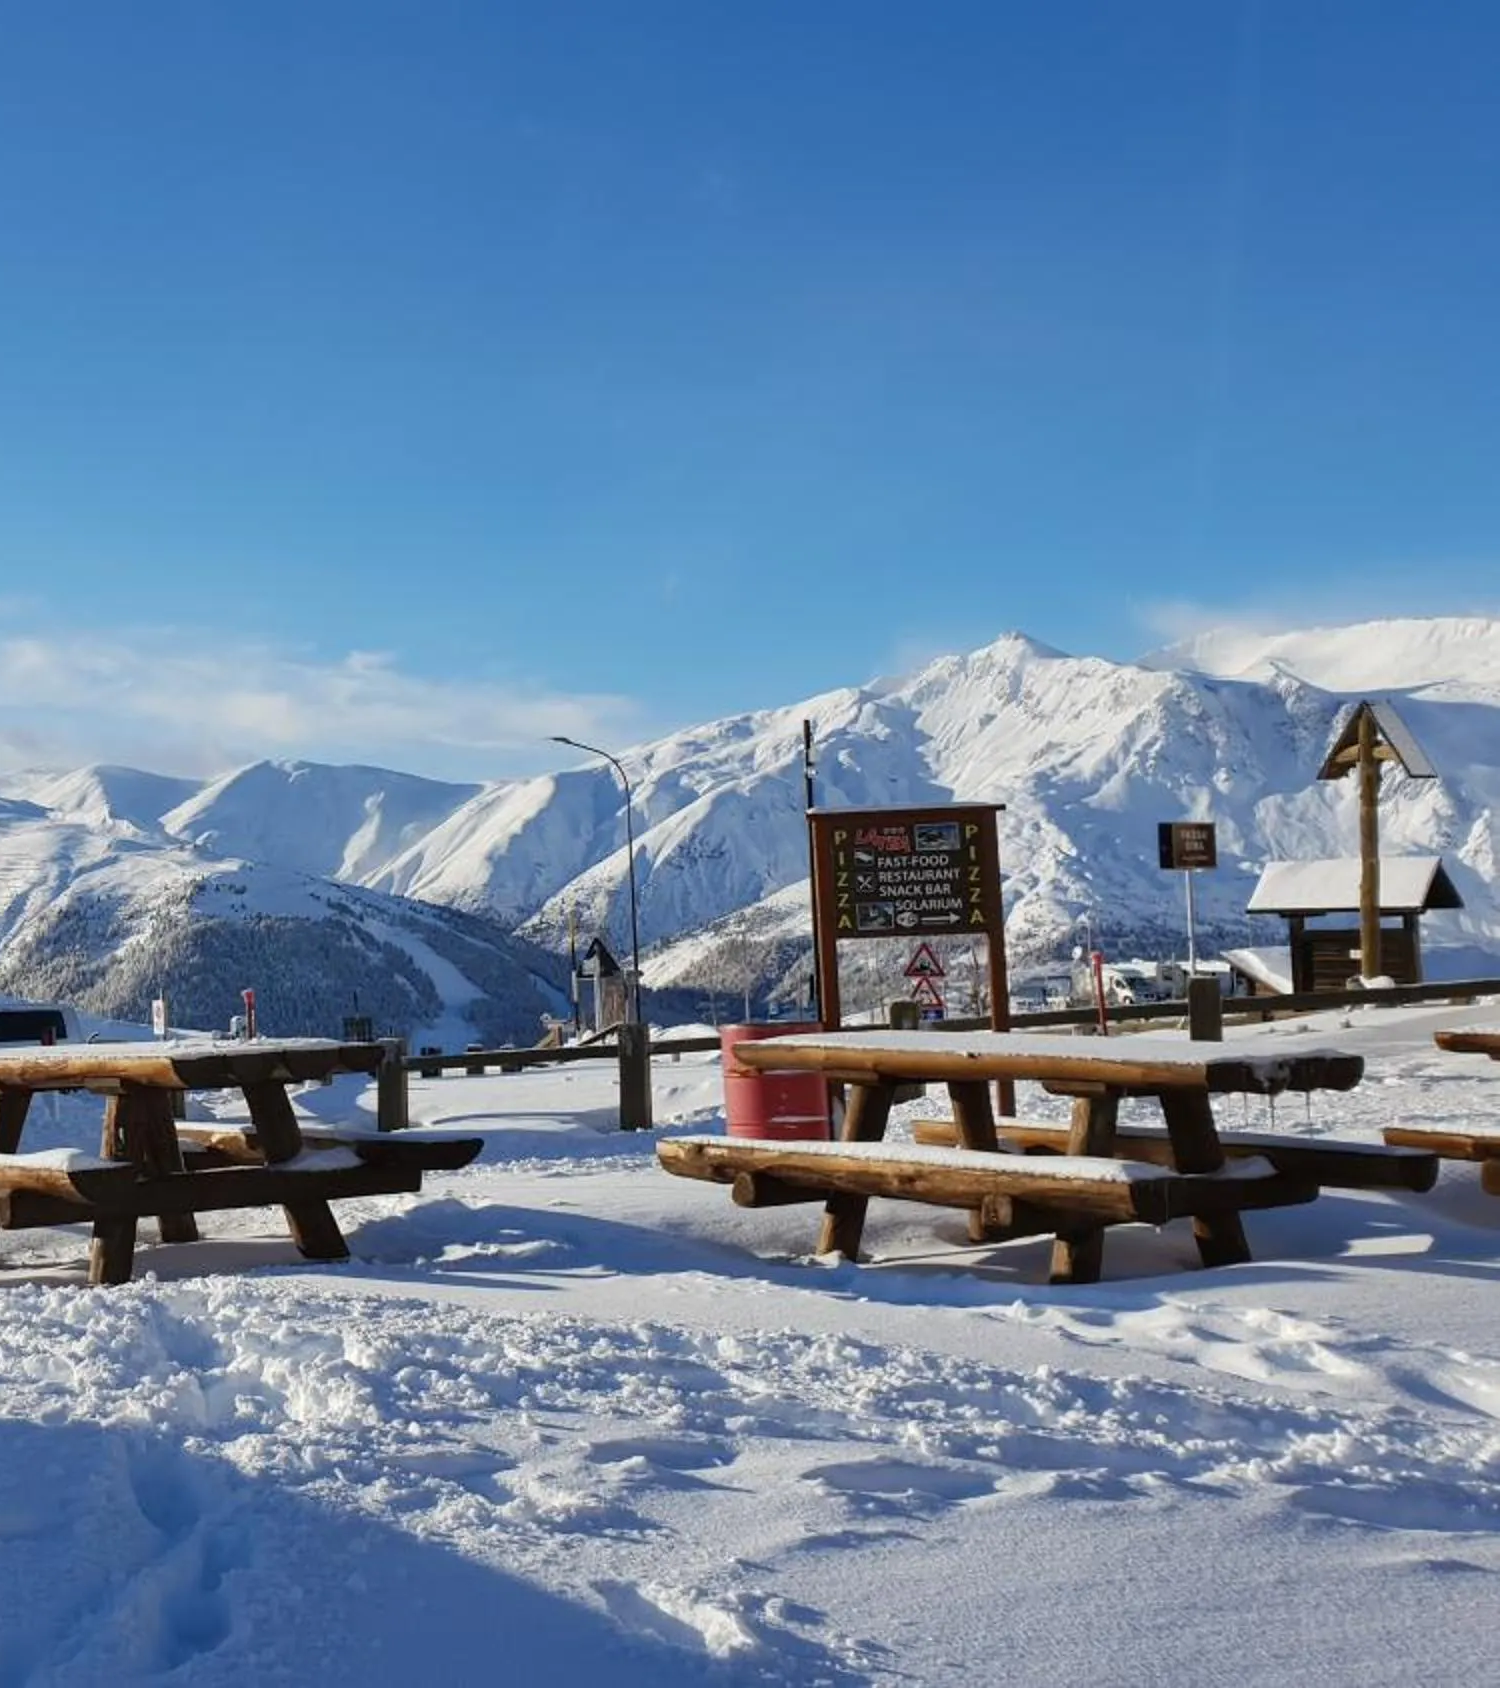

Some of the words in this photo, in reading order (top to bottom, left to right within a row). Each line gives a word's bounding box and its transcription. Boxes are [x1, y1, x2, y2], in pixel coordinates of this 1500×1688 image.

[877, 854, 949, 869] FAST-FOOD
[834, 830, 853, 929] PIZZA
[879, 867, 960, 883] RESTAURANT
[965, 823, 985, 925] PIZZA
[879, 884, 923, 897] SNACK
[925, 883, 951, 896] BAR
[895, 897, 963, 911] SOLARIUM
